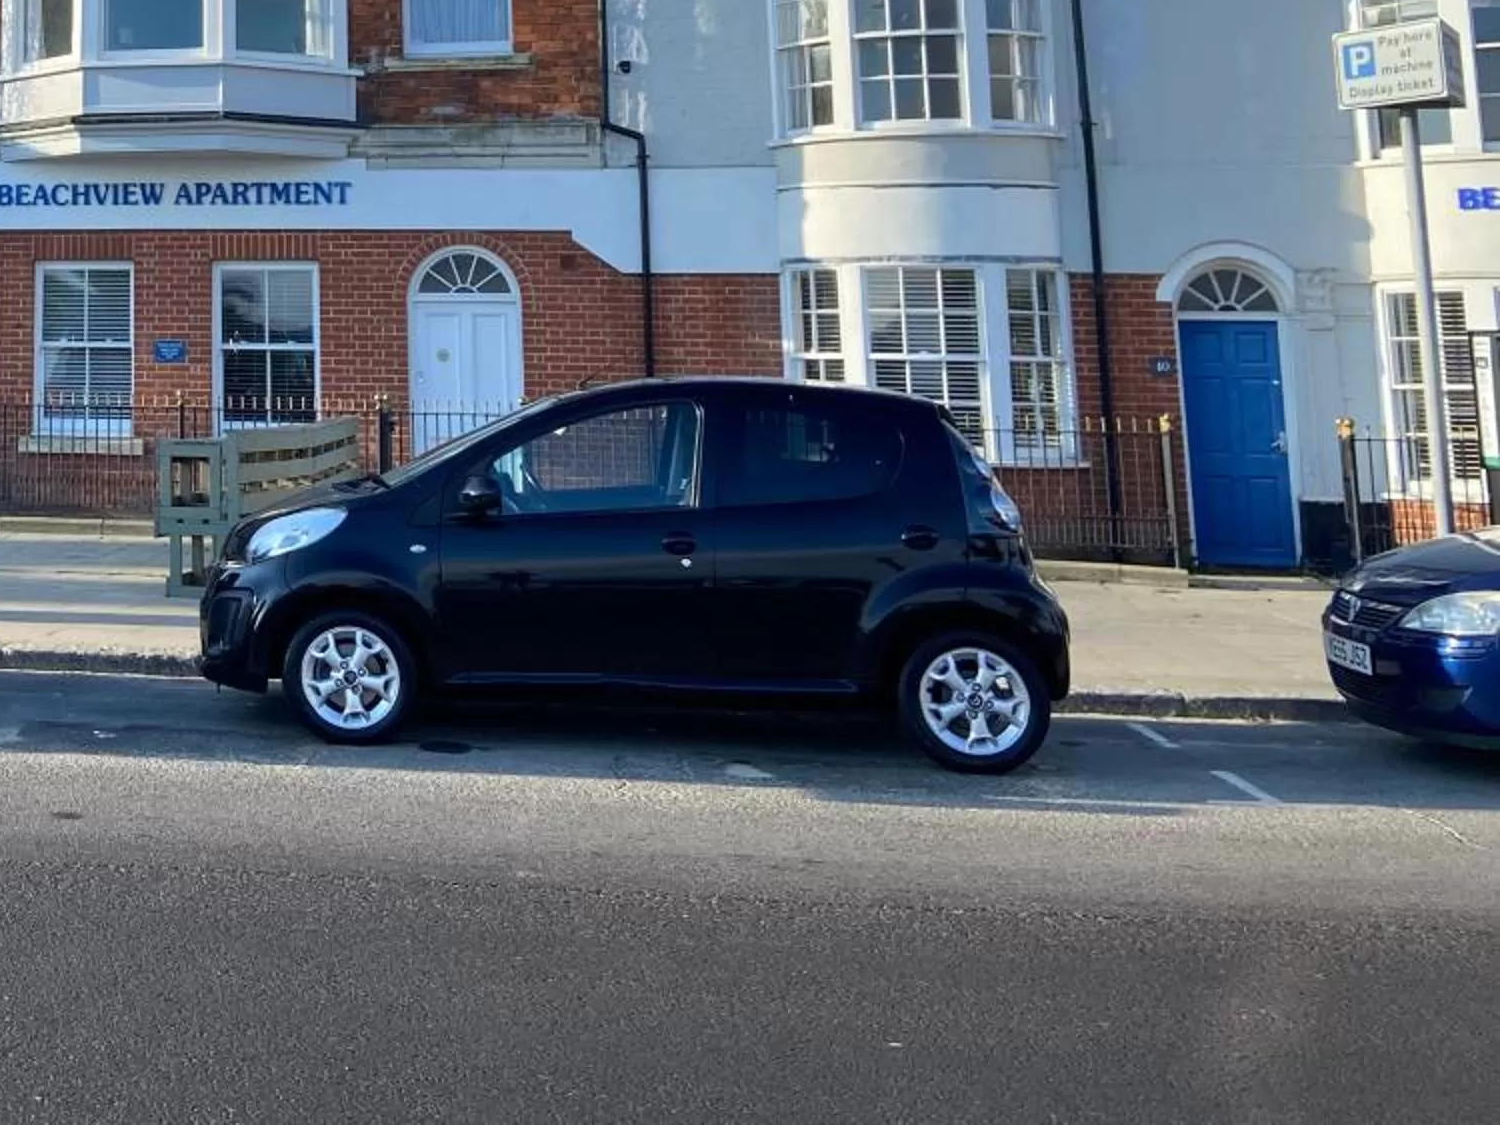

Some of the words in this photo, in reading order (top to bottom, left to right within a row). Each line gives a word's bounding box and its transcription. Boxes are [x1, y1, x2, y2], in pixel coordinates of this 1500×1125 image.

[1377, 35, 1400, 48] Pay
[1402, 30, 1432, 43] here
[1349, 46, 1371, 76] P
[1400, 47, 1411, 59] at
[1381, 59, 1433, 75] machine
[1349, 84, 1393, 98] Display
[1397, 78, 1434, 92] ticket
[173, 181, 352, 206] APARTMENT
